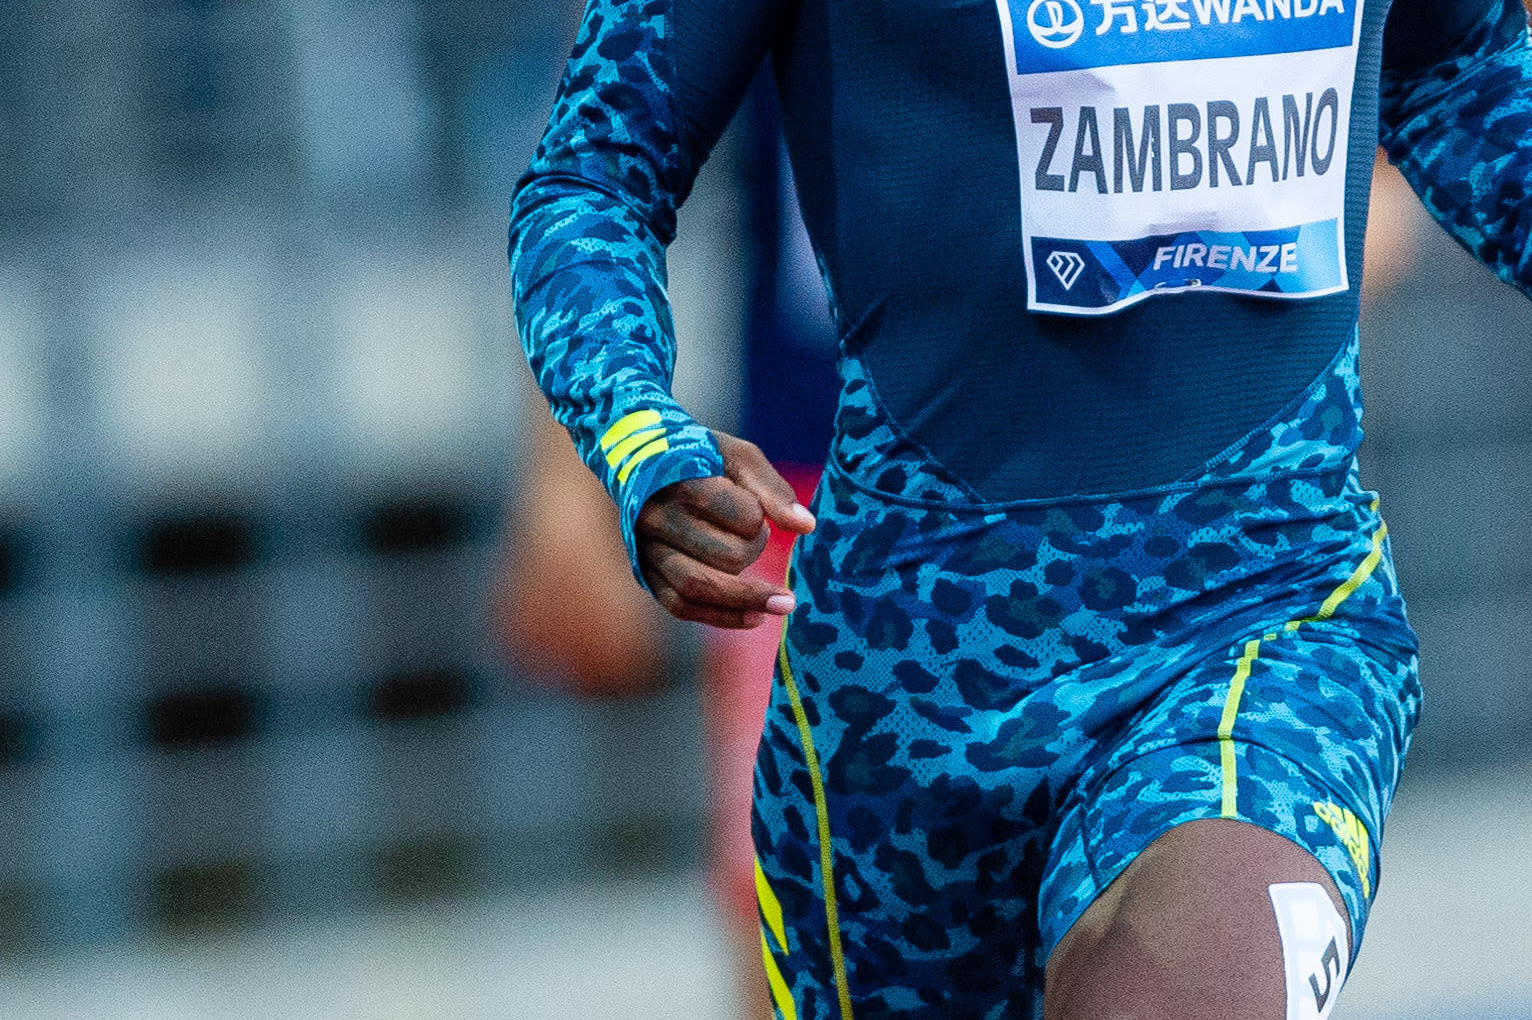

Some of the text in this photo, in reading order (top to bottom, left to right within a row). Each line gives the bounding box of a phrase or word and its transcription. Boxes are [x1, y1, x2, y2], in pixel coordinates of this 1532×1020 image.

[1030, 87, 1339, 195] ZAMBRANO
[1153, 242, 1298, 273] FIRENZE
[1308, 936, 1341, 1014] 5
